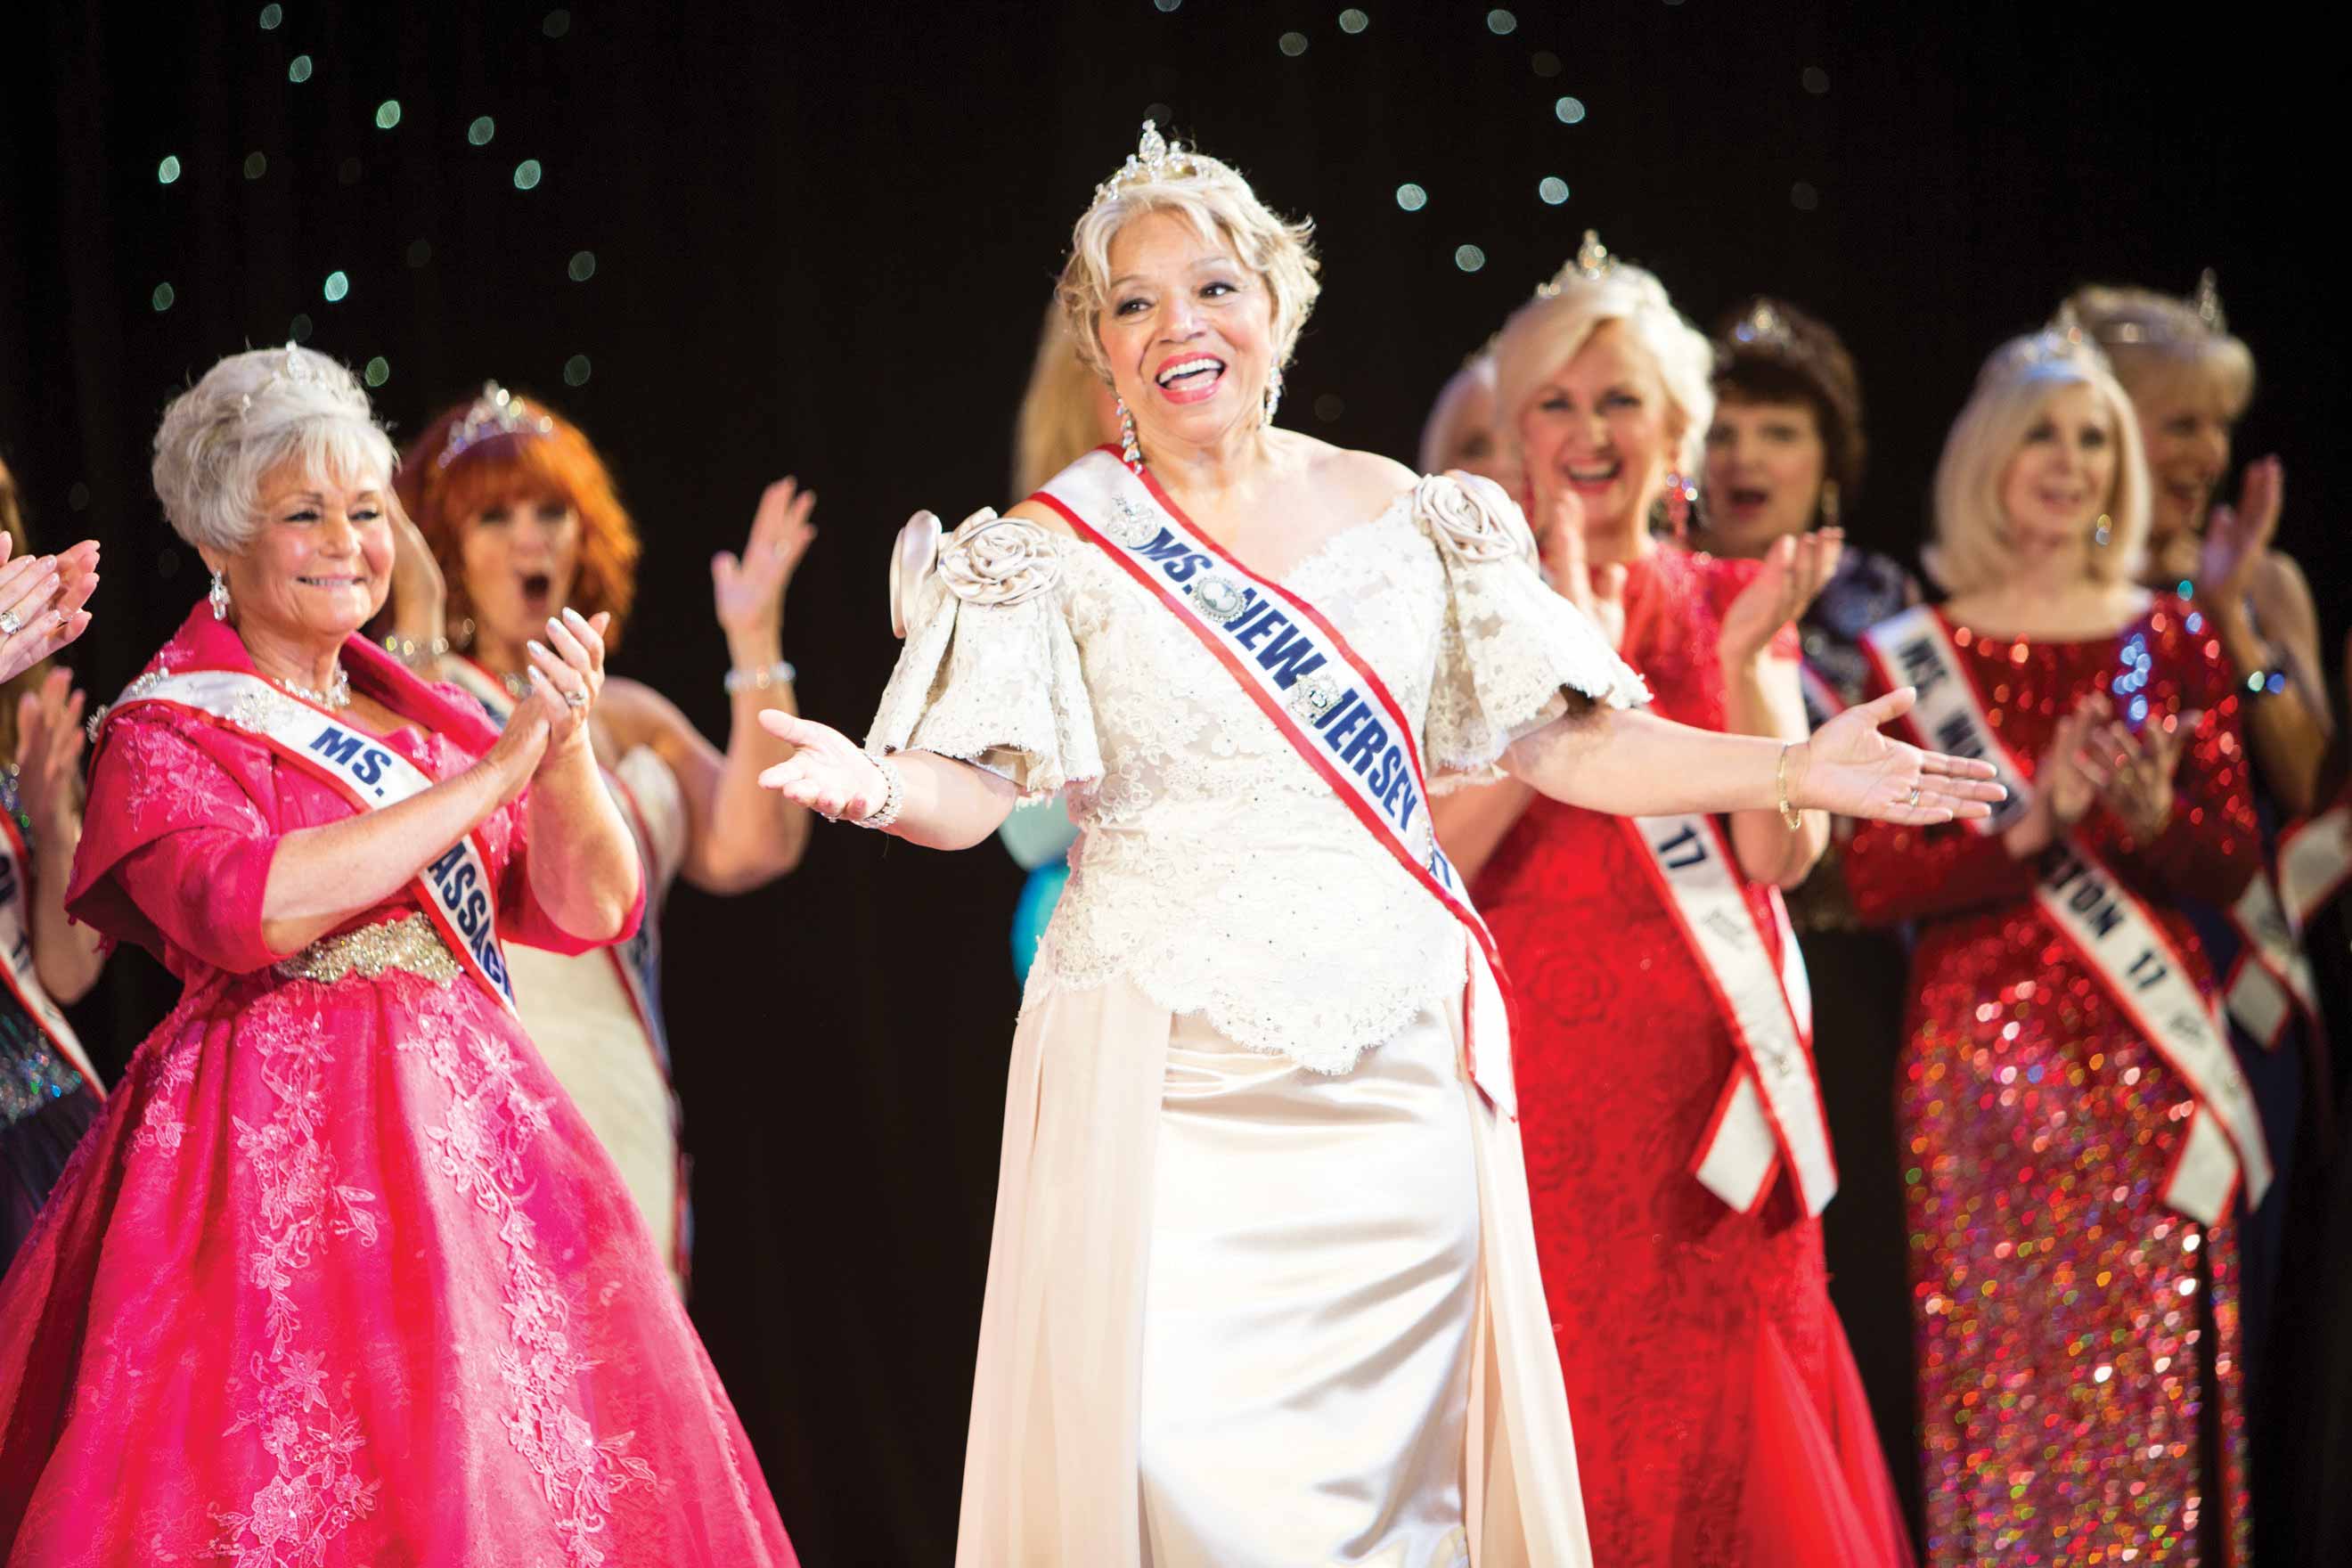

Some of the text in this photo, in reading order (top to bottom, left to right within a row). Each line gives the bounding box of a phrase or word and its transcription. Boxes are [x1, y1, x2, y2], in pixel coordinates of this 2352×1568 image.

[1128, 527, 1213, 595] MS.
[1222, 587, 1327, 691] NEW
[1313, 688, 1417, 832] JERSEY
[309, 726, 517, 1003] MS. ASSAC
[1658, 823, 1707, 870] 17
